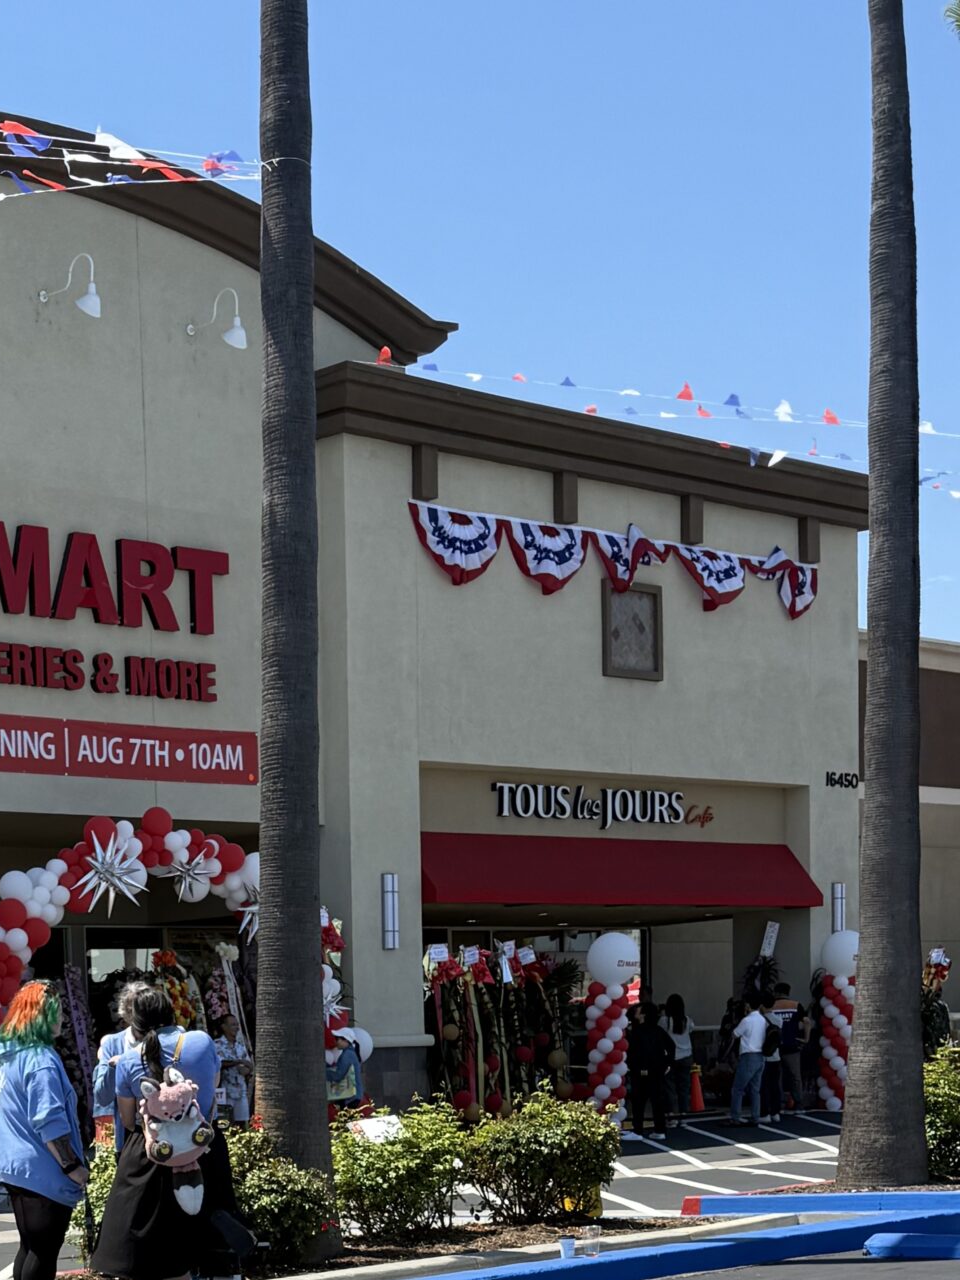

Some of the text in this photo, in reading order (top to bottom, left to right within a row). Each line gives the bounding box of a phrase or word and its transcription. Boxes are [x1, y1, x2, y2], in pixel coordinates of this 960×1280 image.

[91, 652, 119, 694] &
[125, 656, 217, 703] MORE
[77, 735, 124, 765] AUG
[130, 739, 170, 768] 7TH
[189, 744, 243, 772] 10AM
[826, 771, 858, 789] 16450
[491, 781, 570, 819] TOUS
[573, 784, 601, 820] les
[599, 788, 685, 830] JOURS
